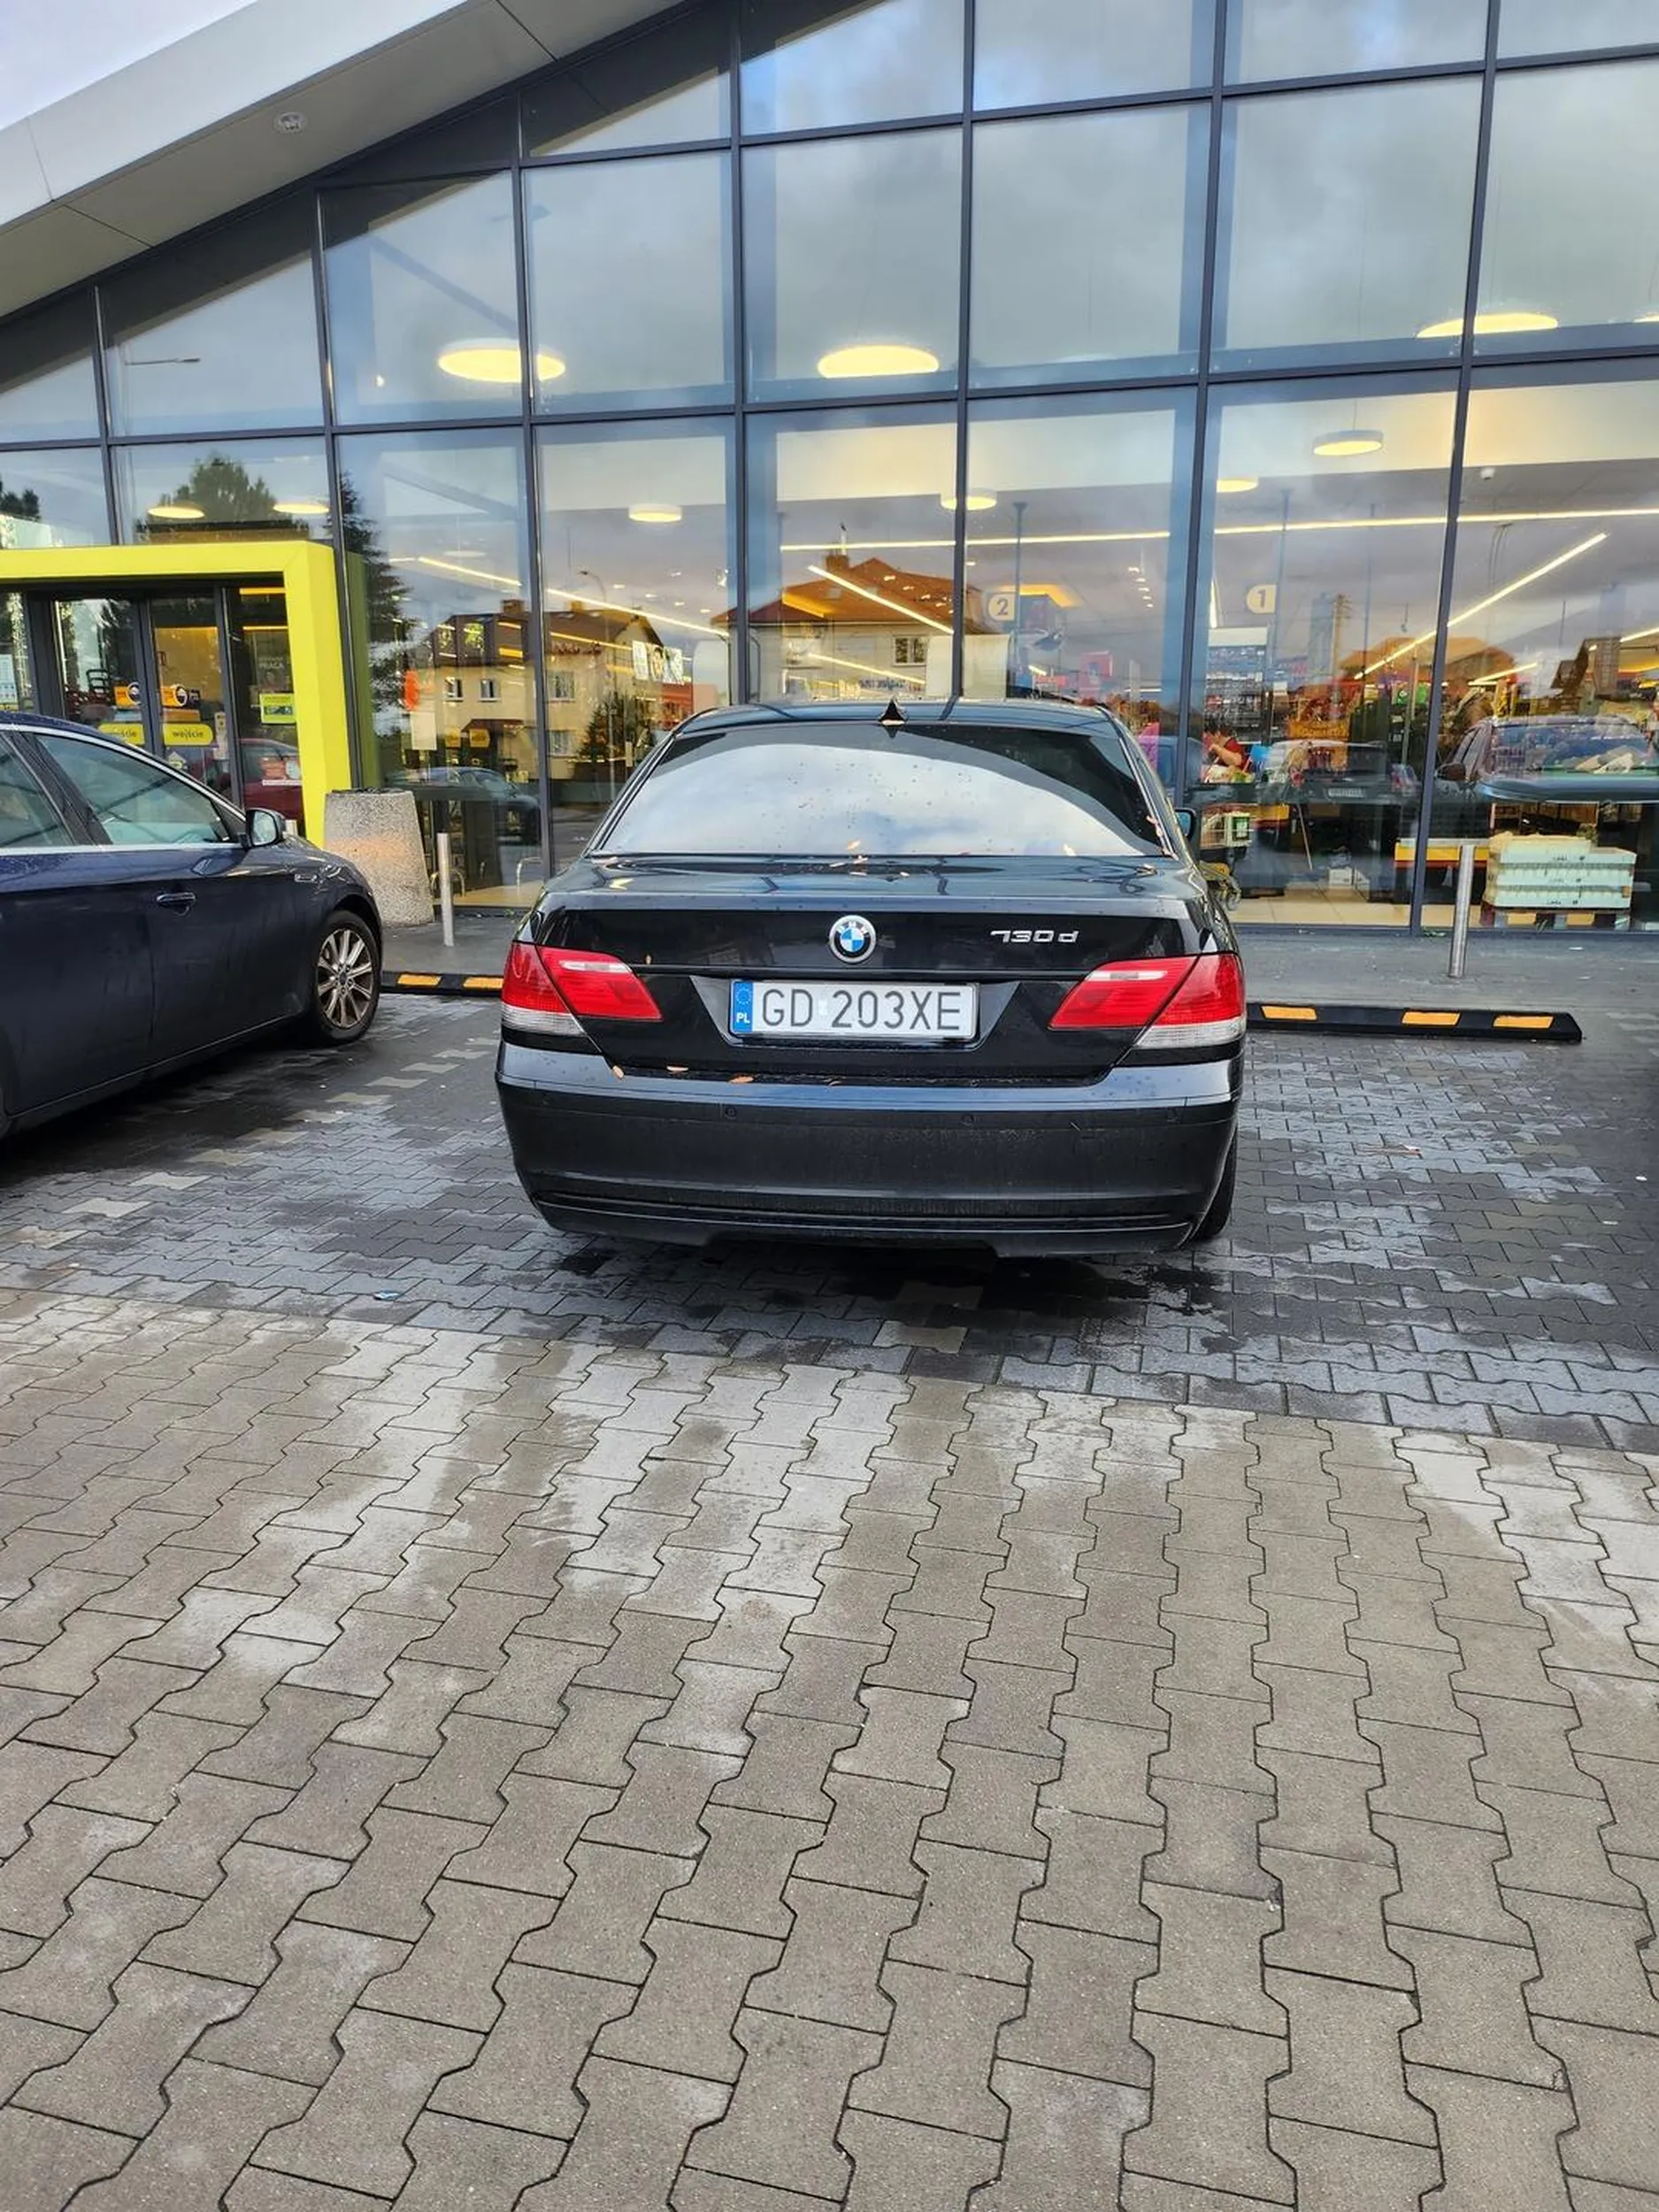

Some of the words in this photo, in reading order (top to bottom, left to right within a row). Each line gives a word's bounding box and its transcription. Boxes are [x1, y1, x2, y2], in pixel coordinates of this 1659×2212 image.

[996, 598, 1008, 615] 2
[1257, 589, 1266, 608] 1
[736, 1012, 750, 1024] PL
[762, 988, 813, 1026] GD
[831, 990, 961, 1030] 203XE
